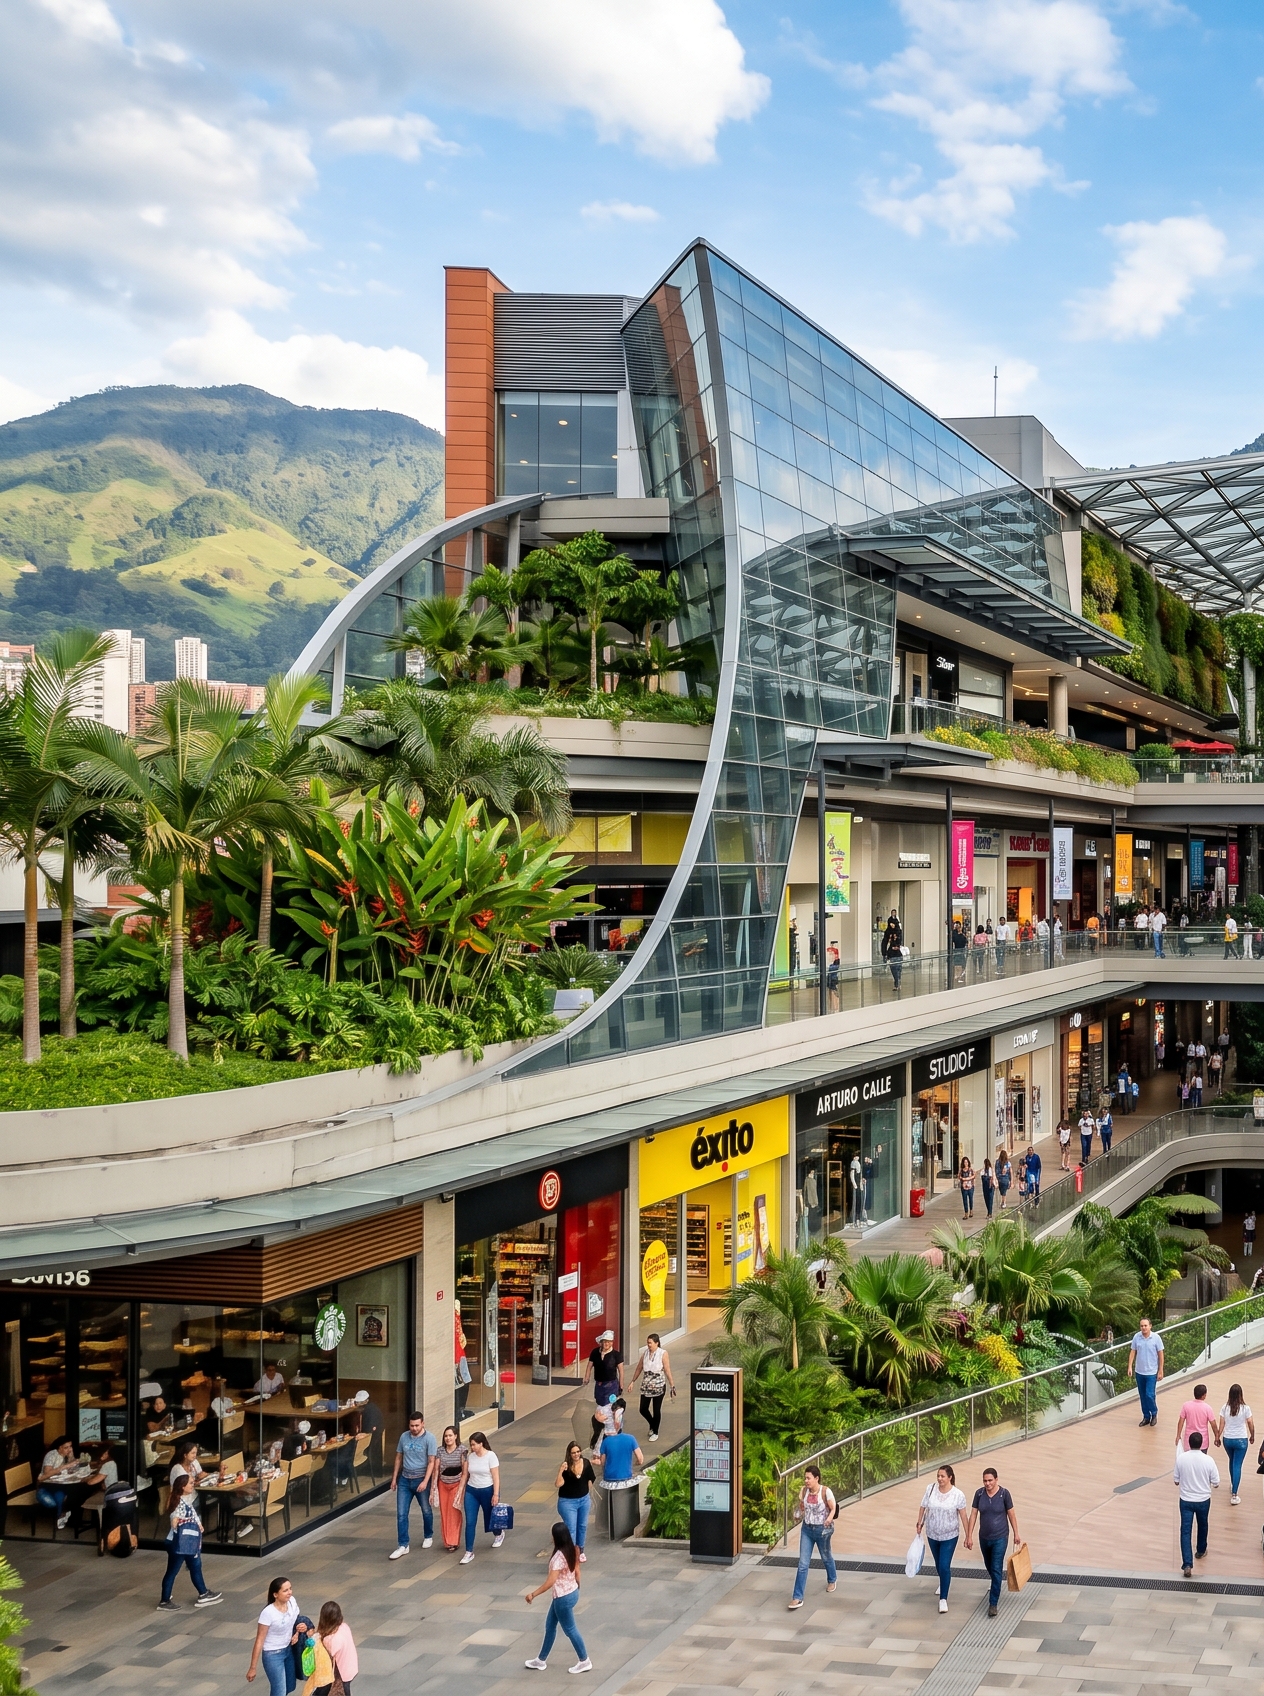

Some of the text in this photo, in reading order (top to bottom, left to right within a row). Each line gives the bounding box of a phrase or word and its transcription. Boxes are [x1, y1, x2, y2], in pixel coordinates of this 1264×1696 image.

[929, 1047, 975, 1080] STUDIO F
[816, 1075, 892, 1116] ARTURO CALLE
[690, 1118, 754, 1172] éxito
